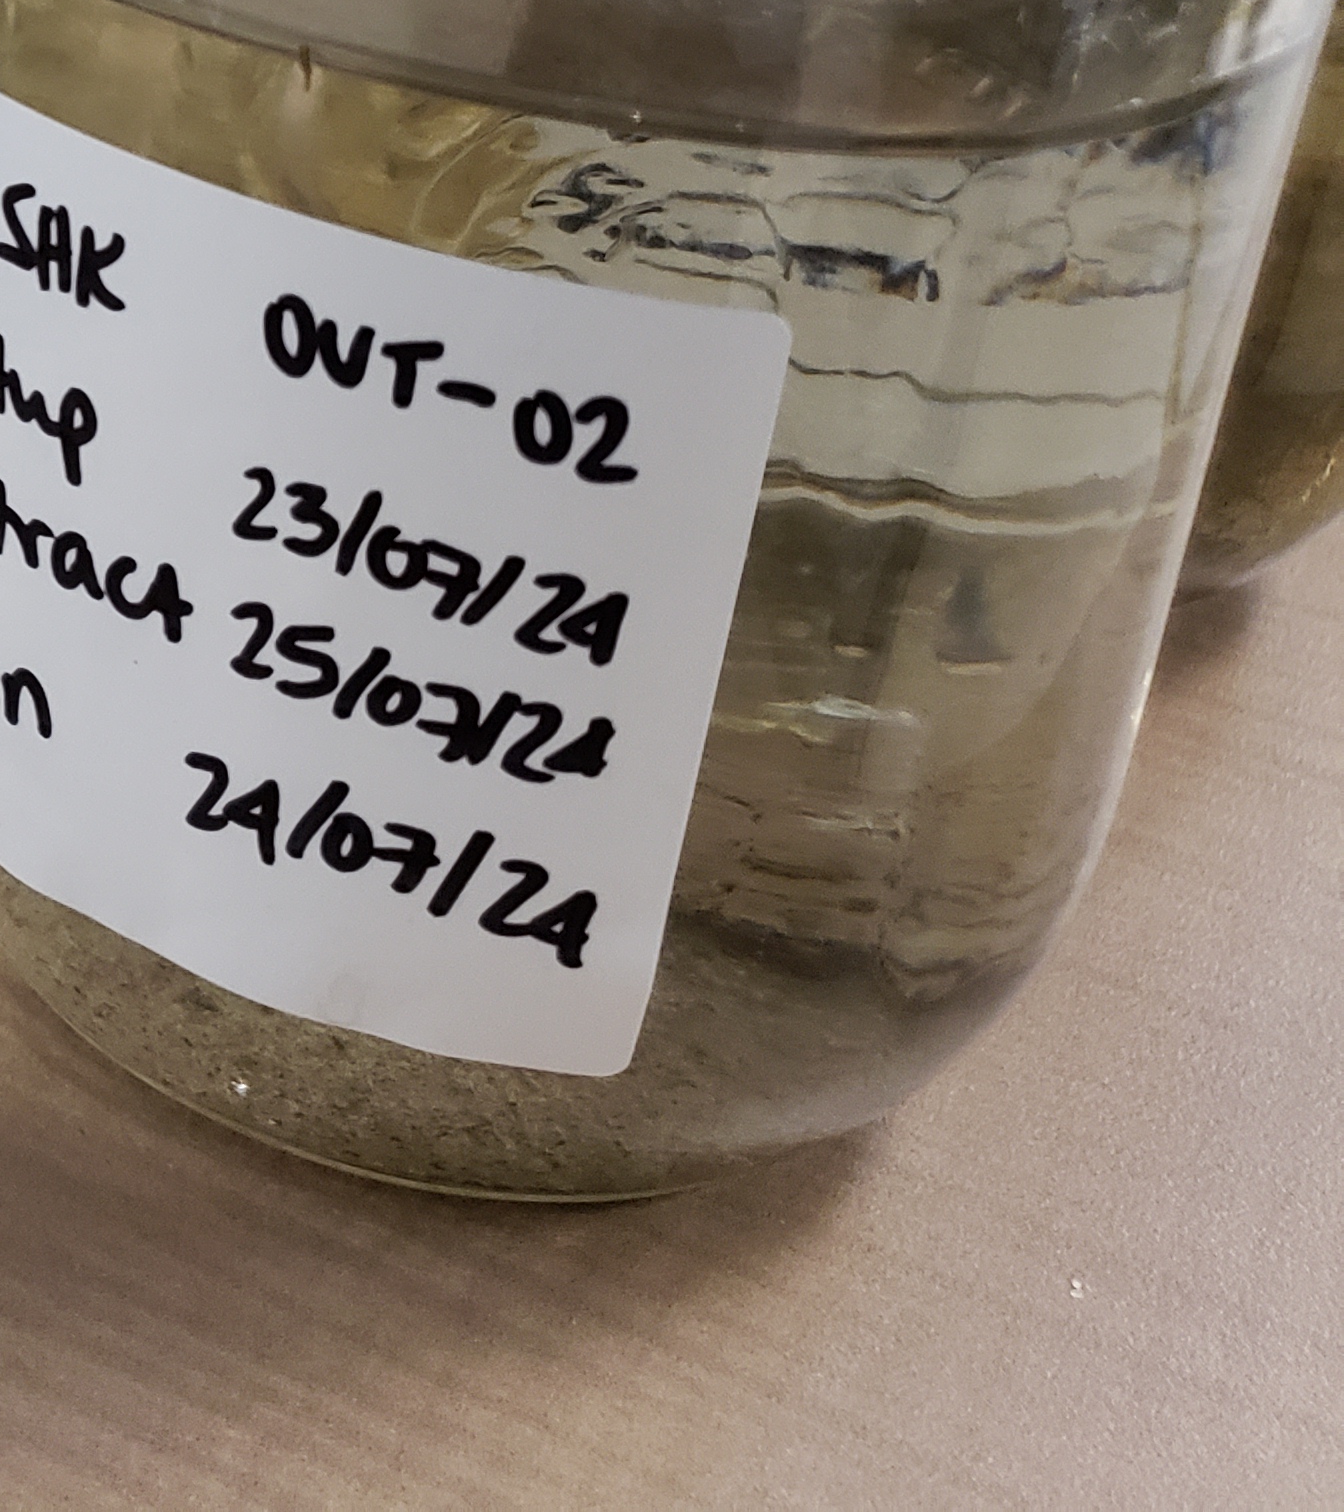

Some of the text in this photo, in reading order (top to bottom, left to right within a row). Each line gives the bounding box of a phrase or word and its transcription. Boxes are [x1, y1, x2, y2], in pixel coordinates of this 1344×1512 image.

[262, 293, 640, 485] OUT-02
[230, 466, 632, 668] 23/07/24
[228, 600, 616, 785] 25/07/24
[183, 751, 602, 970] 24/07/24
